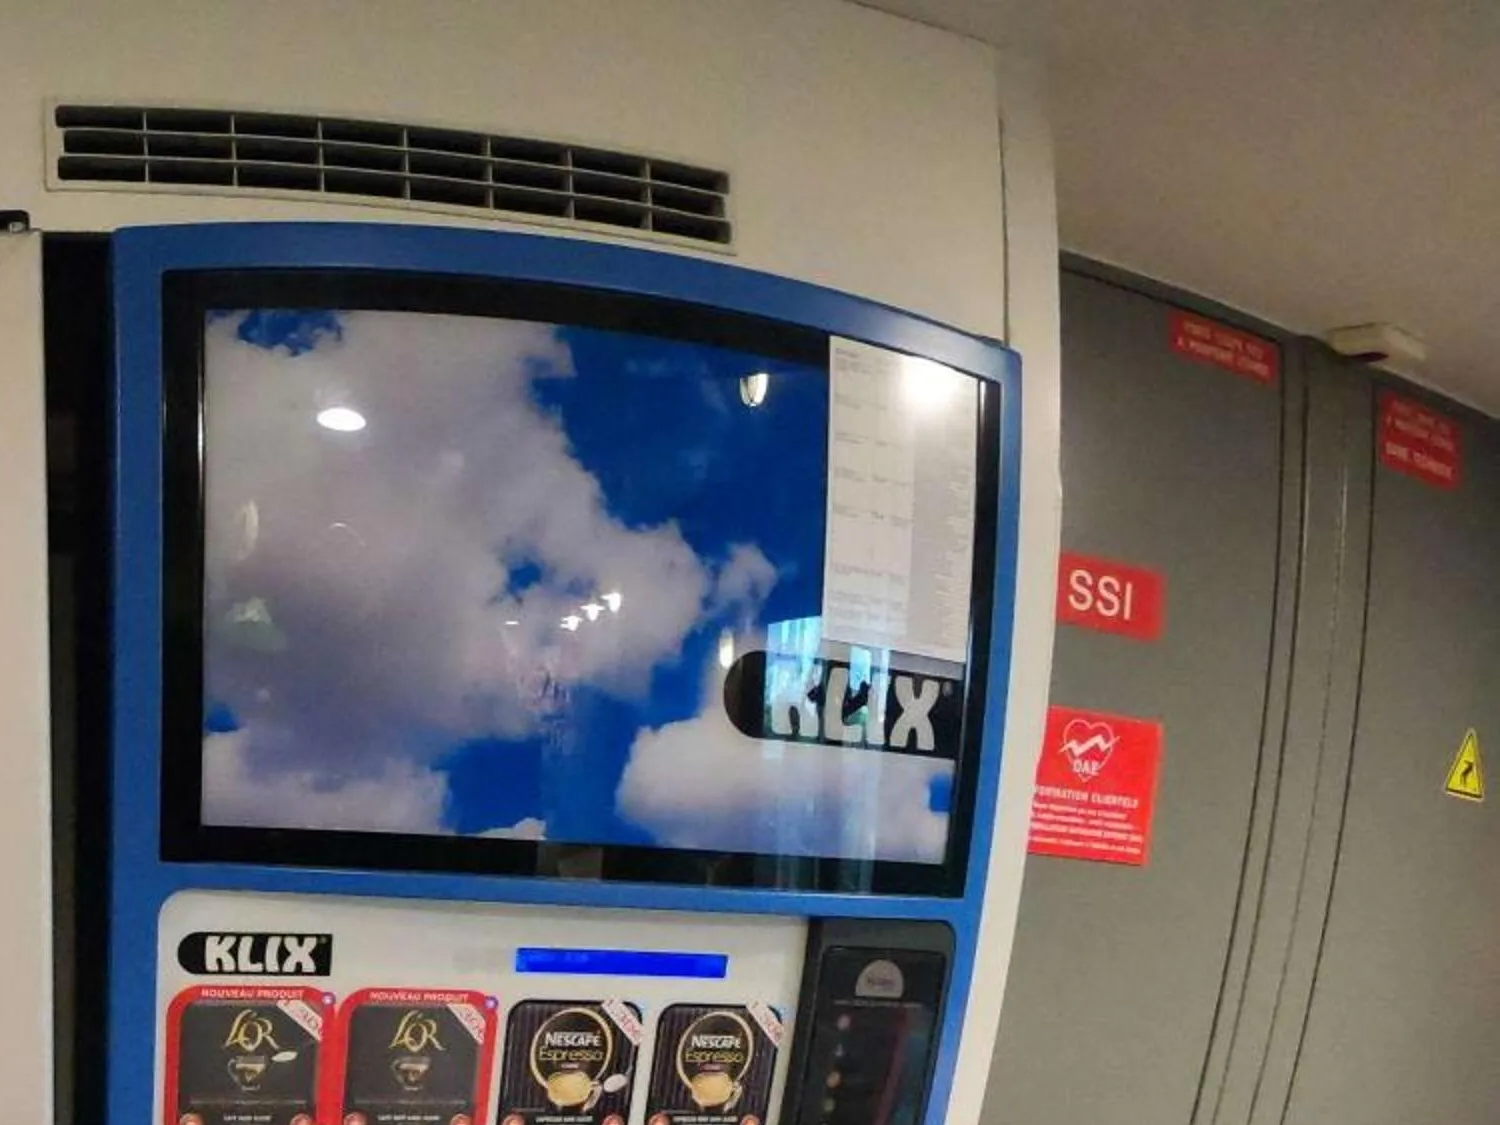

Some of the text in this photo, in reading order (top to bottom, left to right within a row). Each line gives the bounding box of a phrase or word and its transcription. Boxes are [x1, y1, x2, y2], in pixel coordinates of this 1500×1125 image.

[1068, 569, 1133, 620] SSI
[768, 658, 941, 752] KLIX
[205, 935, 317, 974] KLIX
[201, 988, 305, 999] NOUVEAU PRODUIT
[369, 991, 469, 1002] NOUVEAU PRODUIT
[539, 1047, 604, 1062] Espresso
[685, 1051, 745, 1065] Espresso
